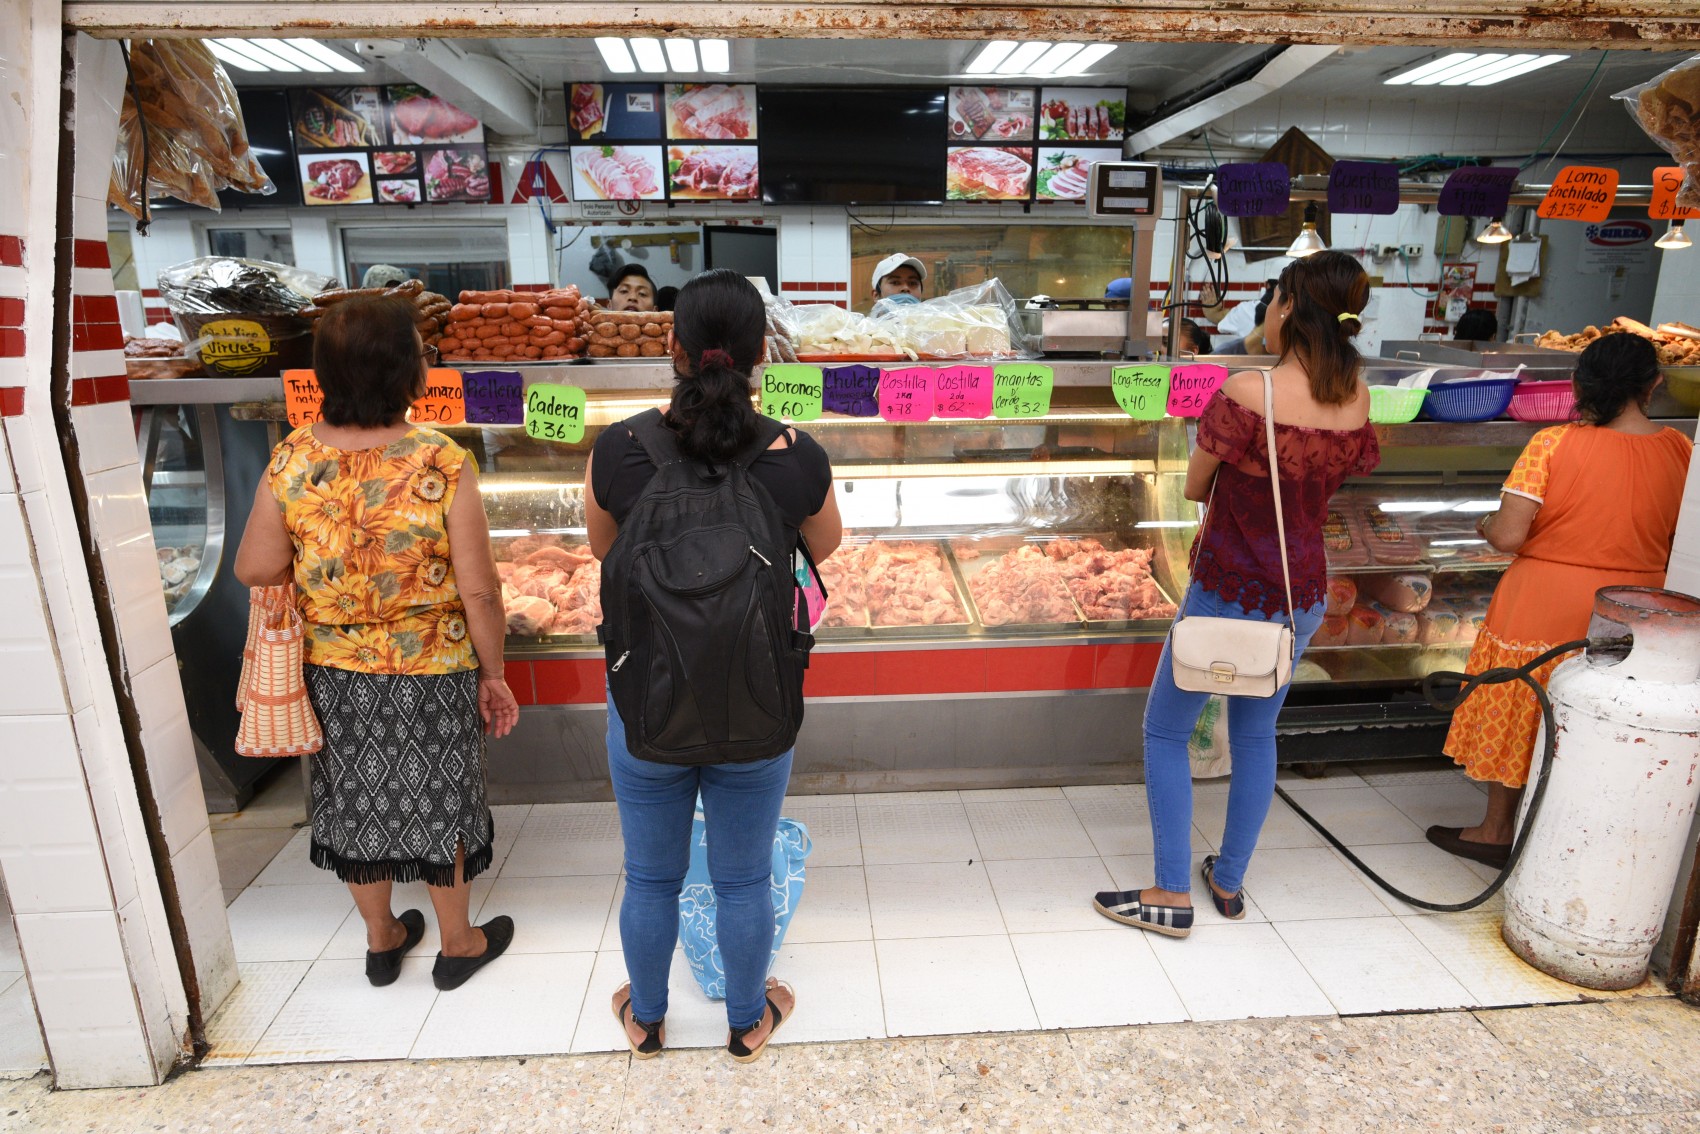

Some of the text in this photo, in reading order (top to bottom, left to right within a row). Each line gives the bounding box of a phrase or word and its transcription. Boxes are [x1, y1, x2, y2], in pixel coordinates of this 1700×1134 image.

[1566, 170, 1607, 185] Lomo
[1548, 186, 1608, 203] Enchilado
[1600, 228, 1648, 238] SIRESA
[765, 374, 822, 399] Boronas
[883, 372, 927, 391] Costilla
[937, 371, 980, 390] Costilla
[1172, 373, 1216, 391] Chorizo
[528, 391, 579, 420] Cadera
